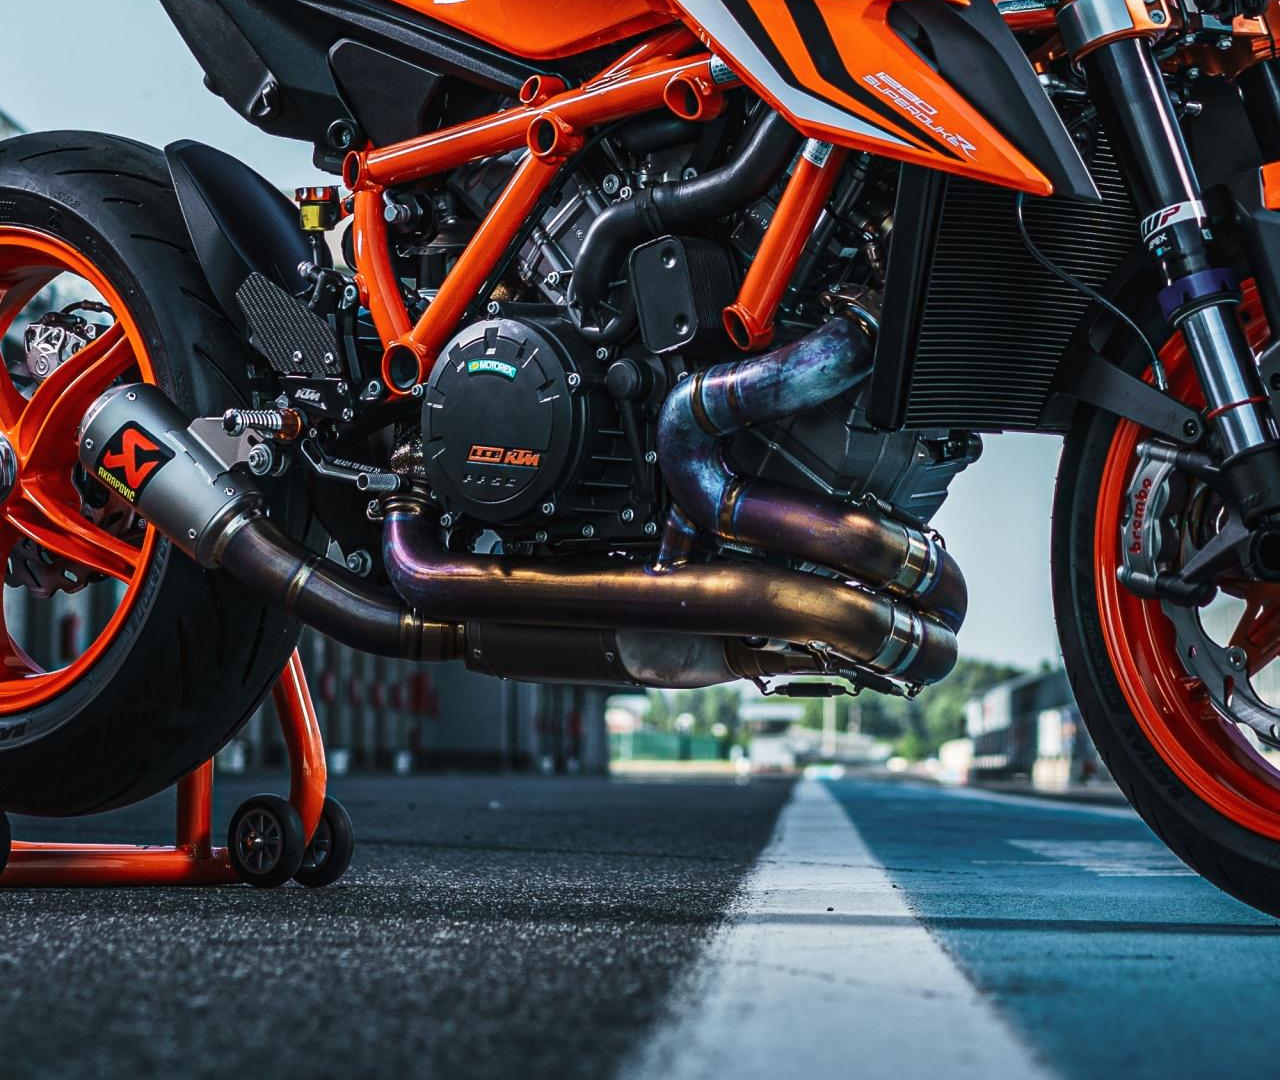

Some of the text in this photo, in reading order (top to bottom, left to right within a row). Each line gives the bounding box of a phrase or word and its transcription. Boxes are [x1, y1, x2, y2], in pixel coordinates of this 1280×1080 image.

[875, 71, 938, 115] 1290
[480, 360, 517, 378] MOTOREX
[294, 388, 320, 401] KTM
[333, 458, 350, 468] READY
[359, 464, 373, 472] RACE
[504, 449, 540, 467] KTM
[1129, 478, 1152, 554] brembo
